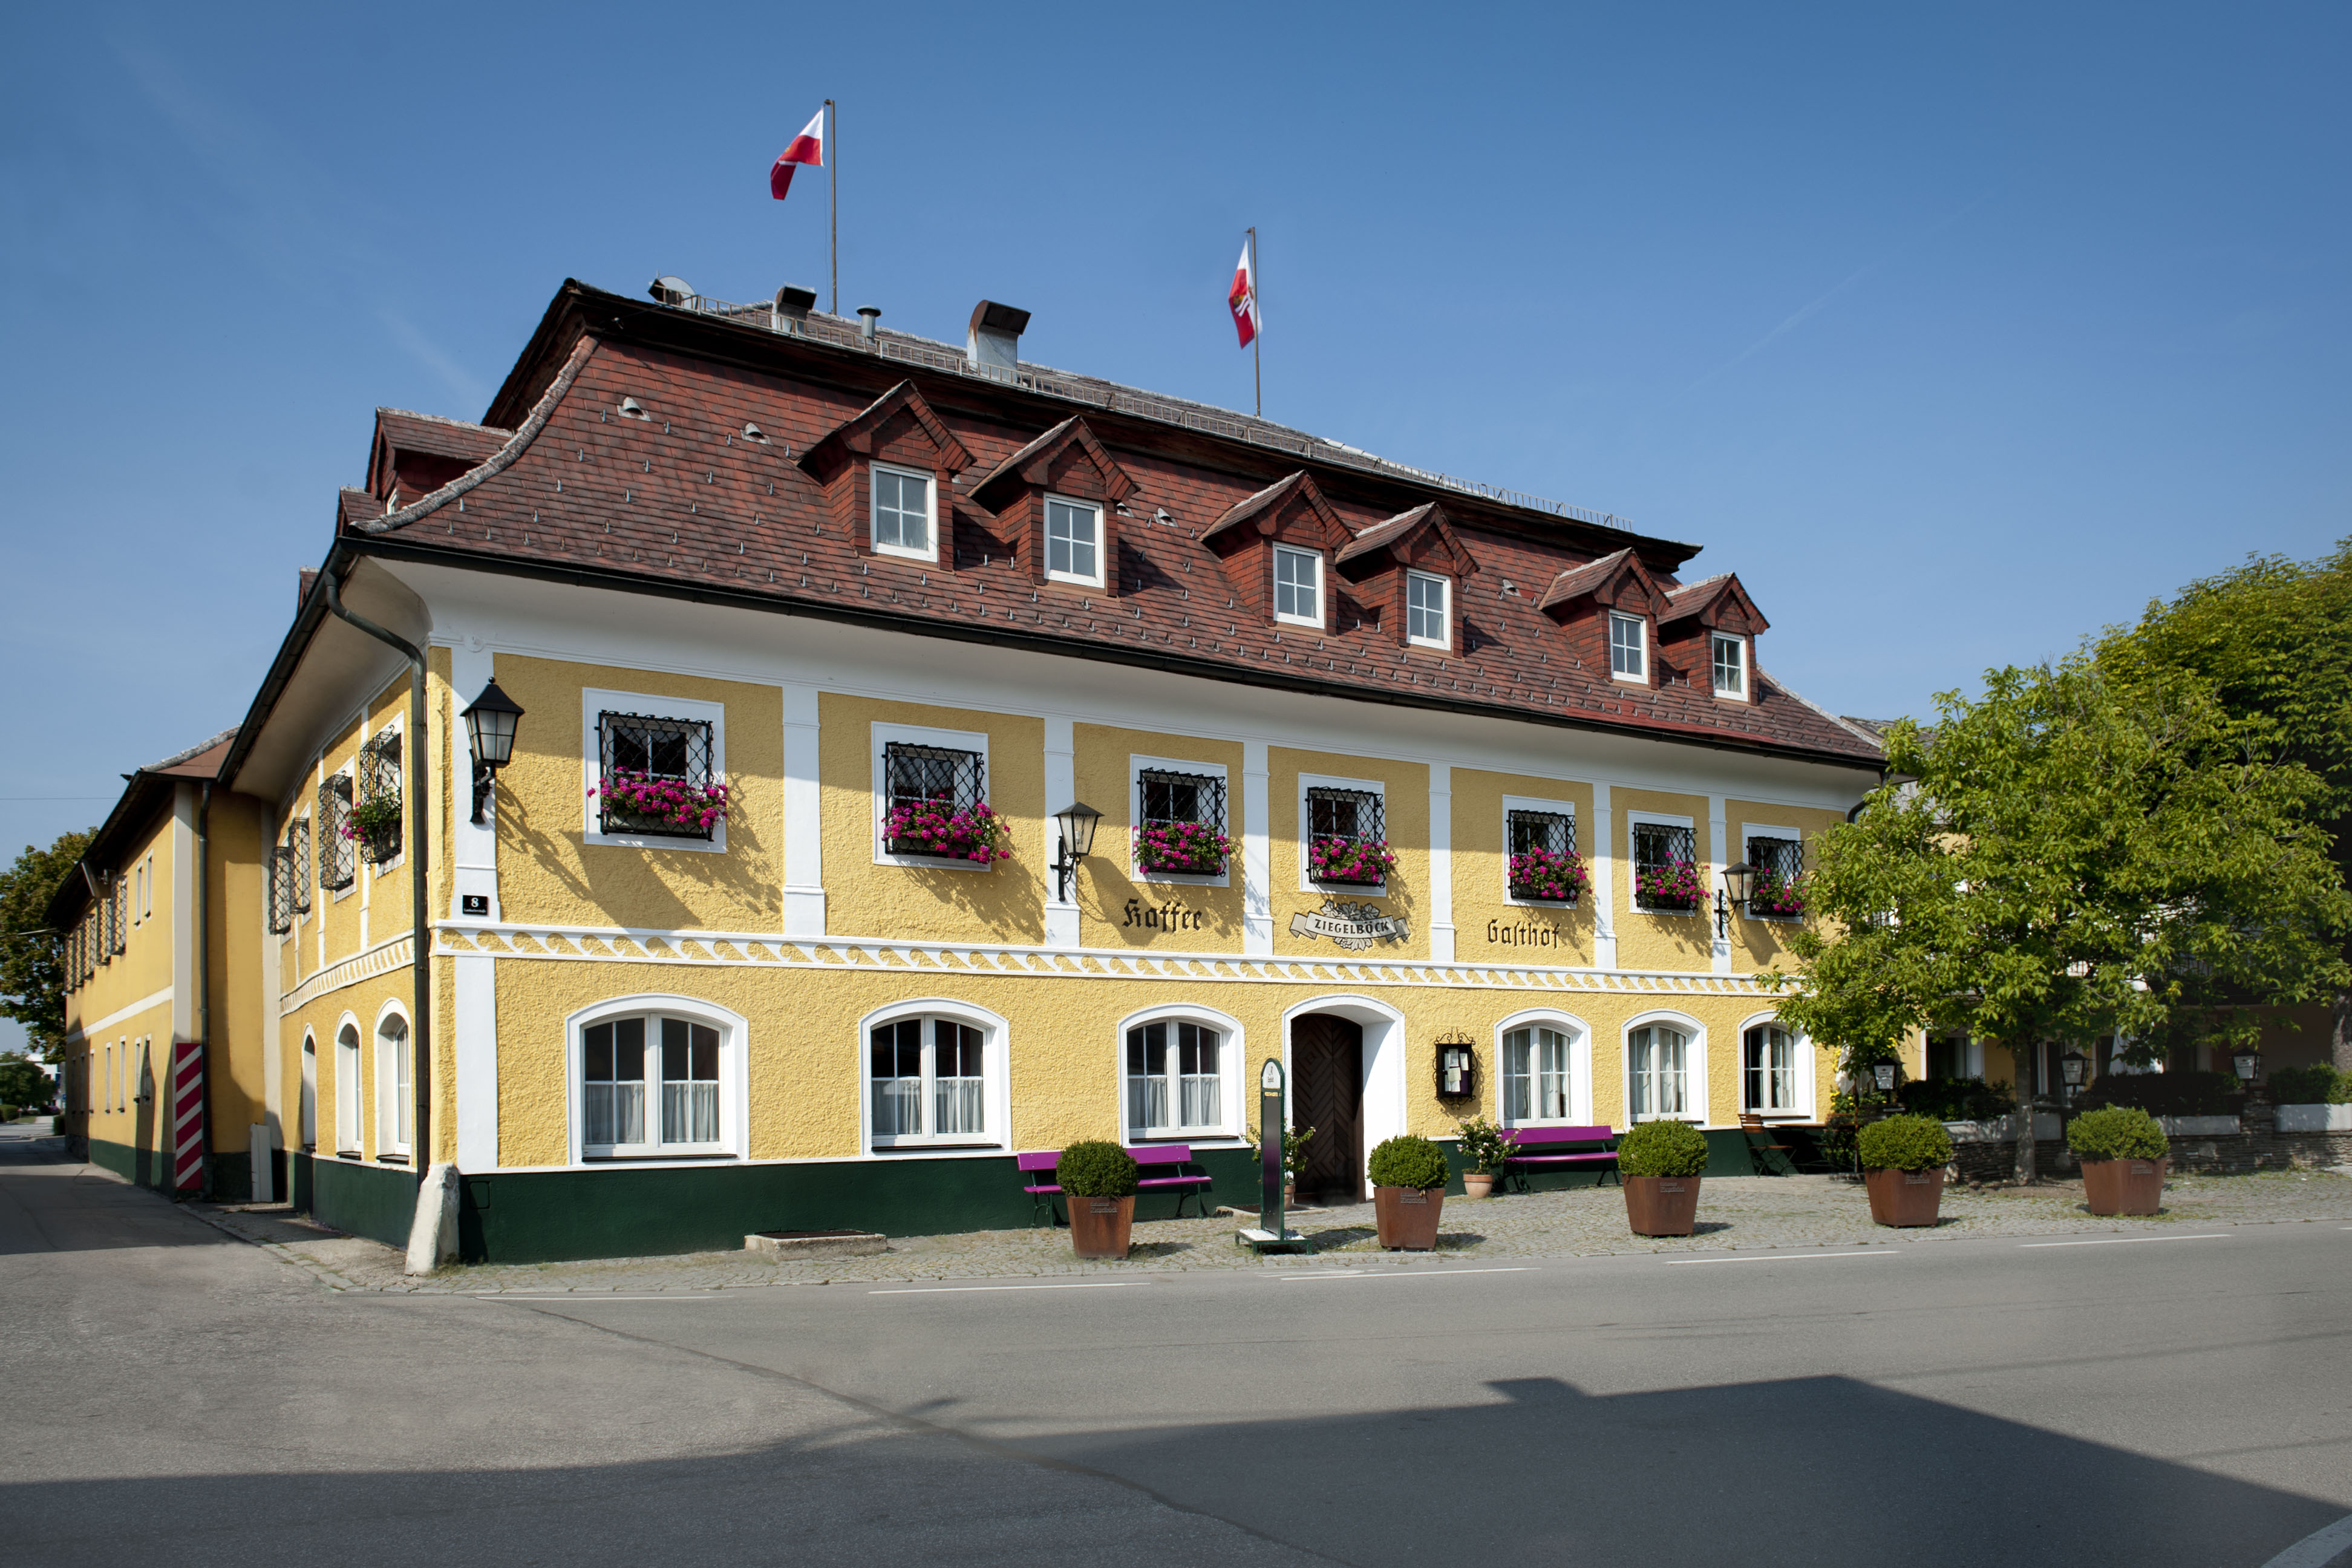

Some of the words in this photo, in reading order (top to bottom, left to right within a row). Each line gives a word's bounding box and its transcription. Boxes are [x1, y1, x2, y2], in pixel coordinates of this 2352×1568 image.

[471, 897, 479, 907] 8
[1122, 898, 1202, 933] Kaffee
[1315, 919, 1390, 935] ZIEGELBÖCK
